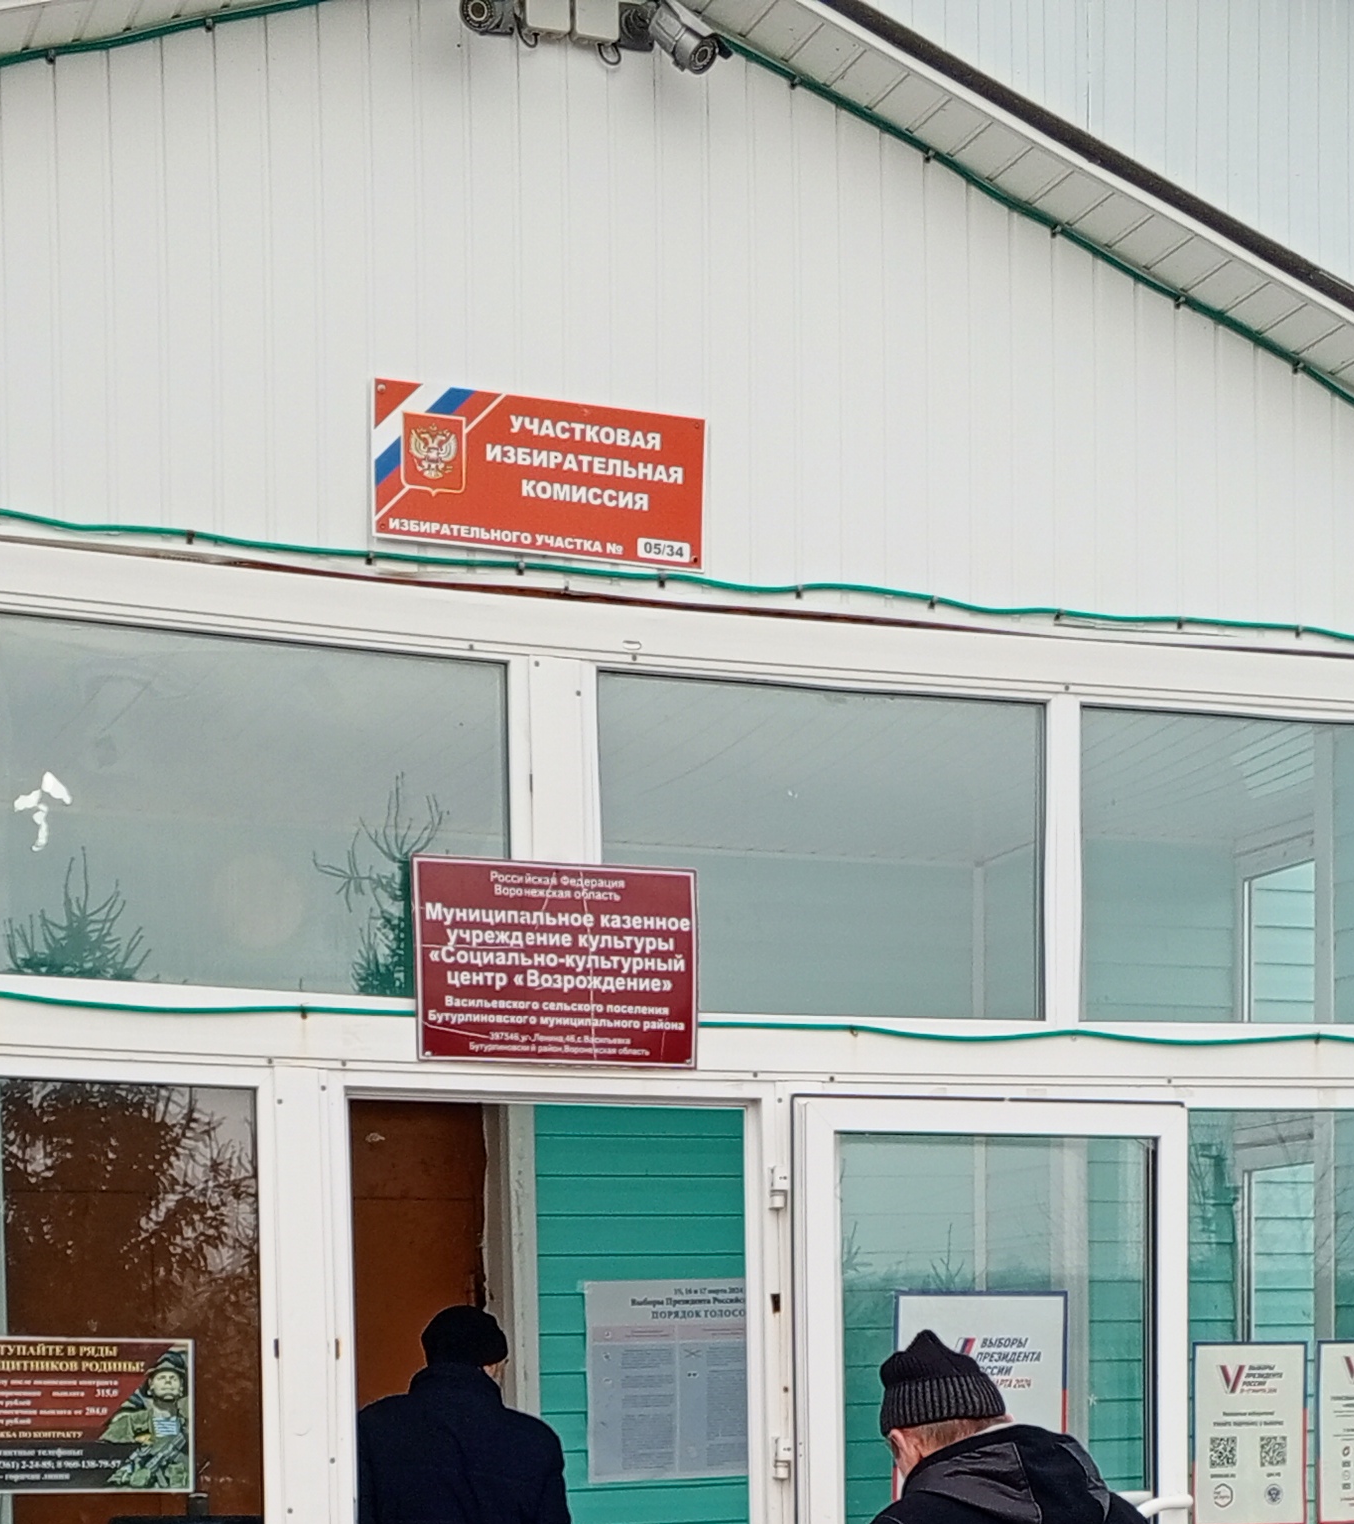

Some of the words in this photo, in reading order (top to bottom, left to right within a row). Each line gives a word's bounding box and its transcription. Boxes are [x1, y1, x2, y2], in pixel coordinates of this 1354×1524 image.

[509, 414, 662, 451] УЧАСТКОВАЯ
[485, 443, 684, 485] ИЗБИРАТЕЛЬНАЯ
[521, 479, 649, 511] КОМИССИЯ
[388, 517, 532, 545] ИЗБИРАТЕЛЬНОГО
[535, 532, 602, 554] УЧАСТКА
[606, 542, 623, 556] №
[643, 541, 684, 559] 05/34
[490, 871, 557, 887] Российская
[561, 875, 625, 889] Федерация
[494, 884, 571, 899] Воронежская
[574, 888, 621, 901] область
[425, 902, 594, 928] Муниципальное
[600, 913, 691, 932] казенное
[447, 928, 572, 948] учреждение
[578, 932, 674, 951] культуры
[429, 946, 685, 973] «Социально-культурный
[447, 970, 507, 990] центр
[513, 968, 673, 993] «Возрождение»
[445, 995, 540, 1010] Васильевского
[542, 1001, 604, 1013] сельского
[606, 1003, 670, 1016] поселения
[428, 1009, 537, 1025] Бутурлиновского
[540, 1014, 640, 1029] муниципального
[643, 1018, 685, 1032] района
[651, 1310, 702, 1320] ПОРЯДОК
[67, 1345, 76, 1356] В
[79, 1346, 118, 1357] РЯДЫ
[980, 1337, 1028, 1348] ВЫБОРЫ
[81, 1361, 145, 1373] РОДИНЫ!
[976, 1351, 1042, 1363] ПРЕЗИДЕНТА
[18, 1431, 32, 1439] ПО
